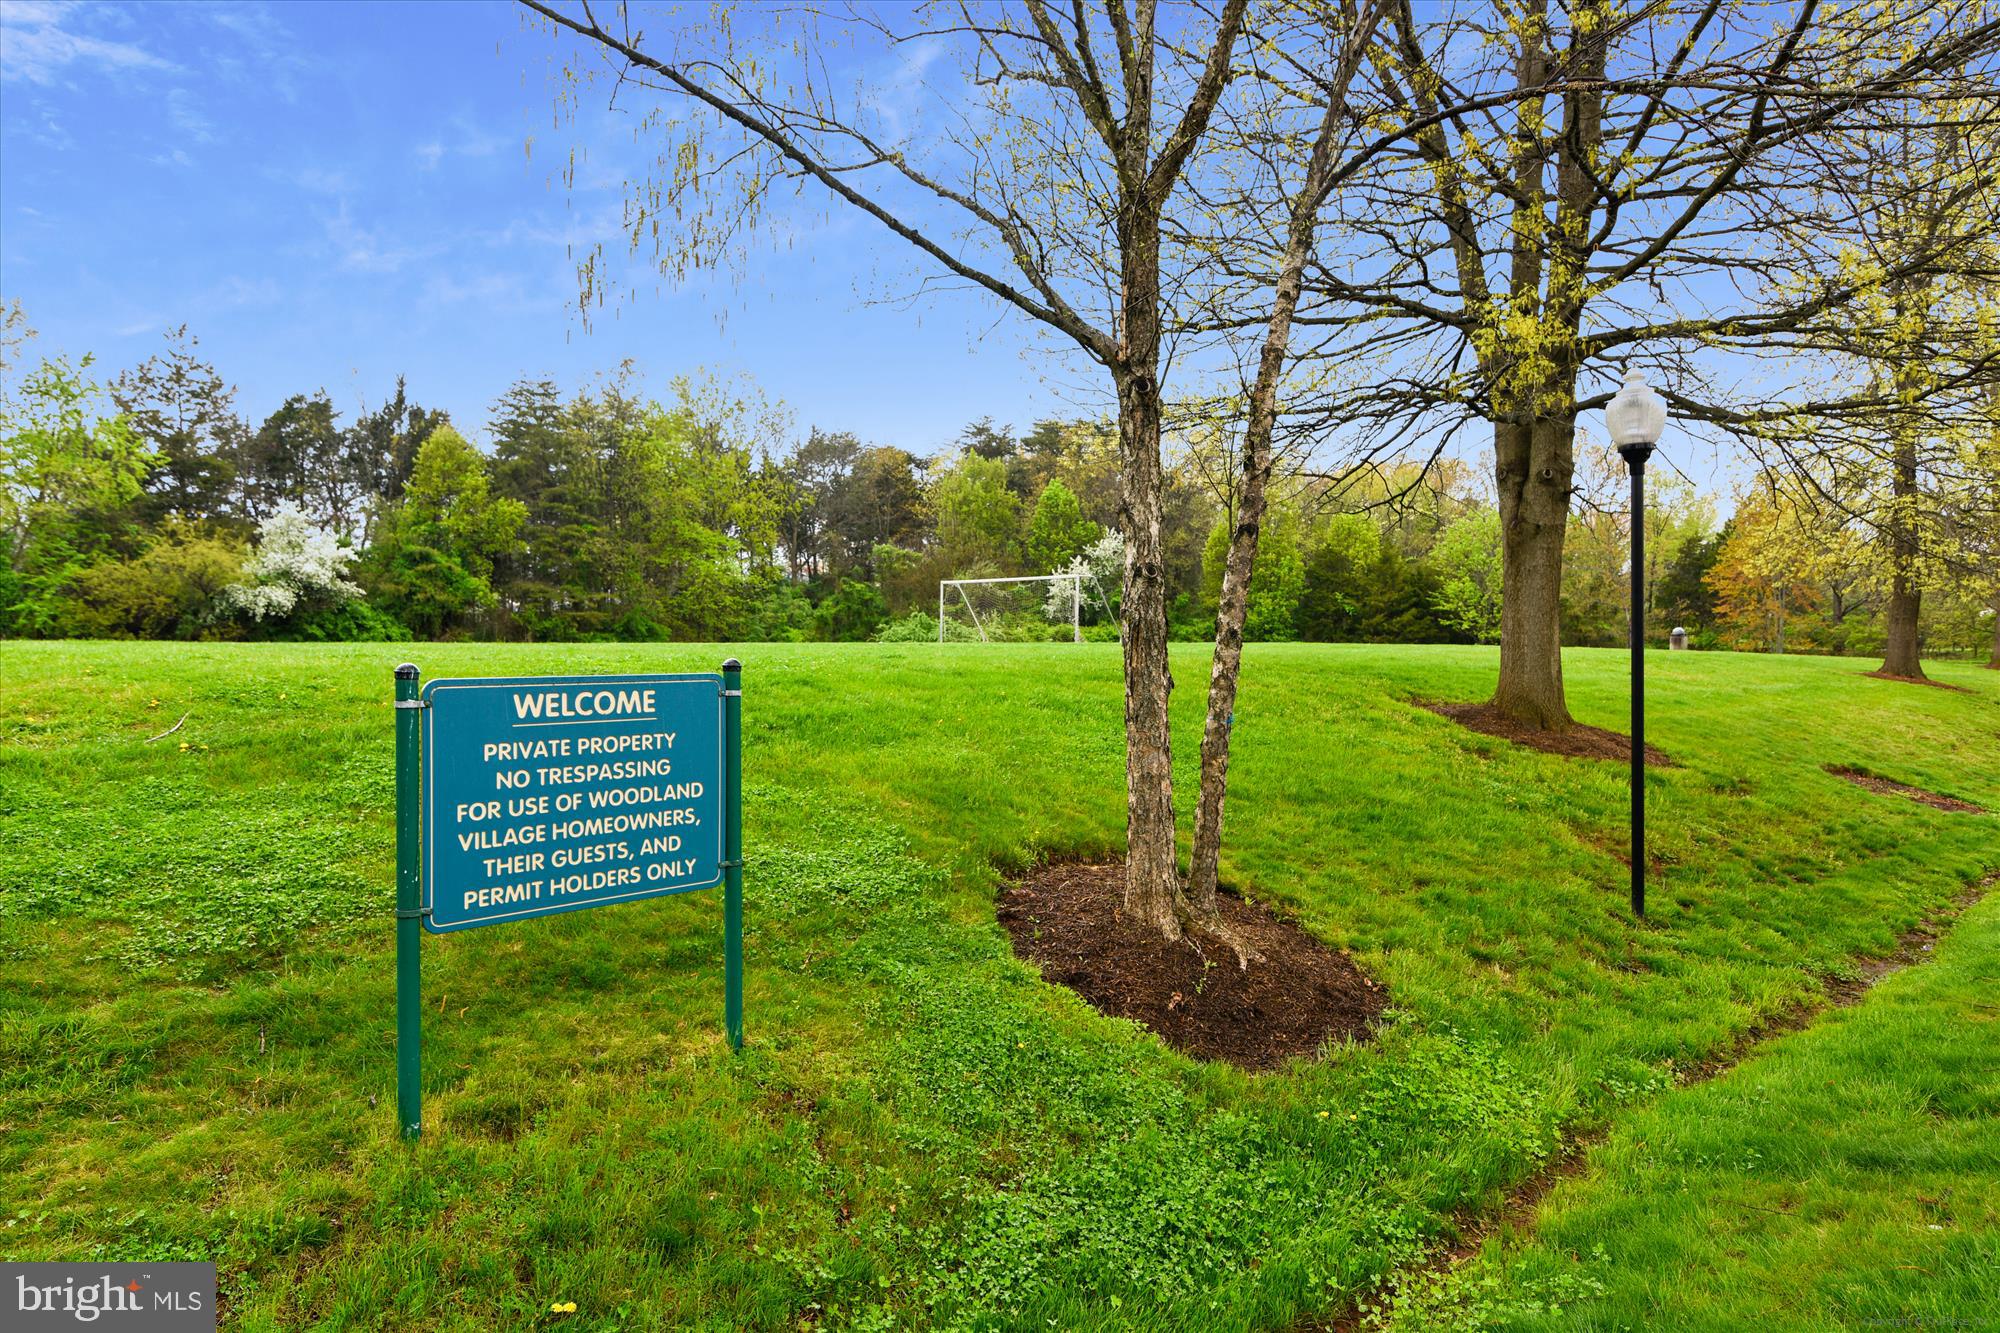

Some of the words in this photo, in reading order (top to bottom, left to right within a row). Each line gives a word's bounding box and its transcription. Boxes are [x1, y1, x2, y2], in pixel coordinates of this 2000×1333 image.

[513, 689, 656, 718] WELCOME
[483, 738, 571, 762] PRIVATE
[577, 732, 676, 755] PROPERTY
[496, 769, 531, 790] NO
[536, 758, 671, 786] TRESPASSING
[456, 801, 502, 823] FOR
[508, 796, 549, 817] USE
[555, 792, 583, 812] OF
[588, 781, 704, 809] WOODLAND
[457, 824, 546, 852] VILLAGE
[552, 807, 701, 841] HOMEOWNERS,
[483, 852, 545, 878] THEIR
[551, 841, 635, 868] GUESTS,
[639, 835, 682, 856] AND
[463, 880, 544, 910] PERMIT
[550, 866, 641, 896] HOLDERS
[646, 858, 697, 881] ONLY
